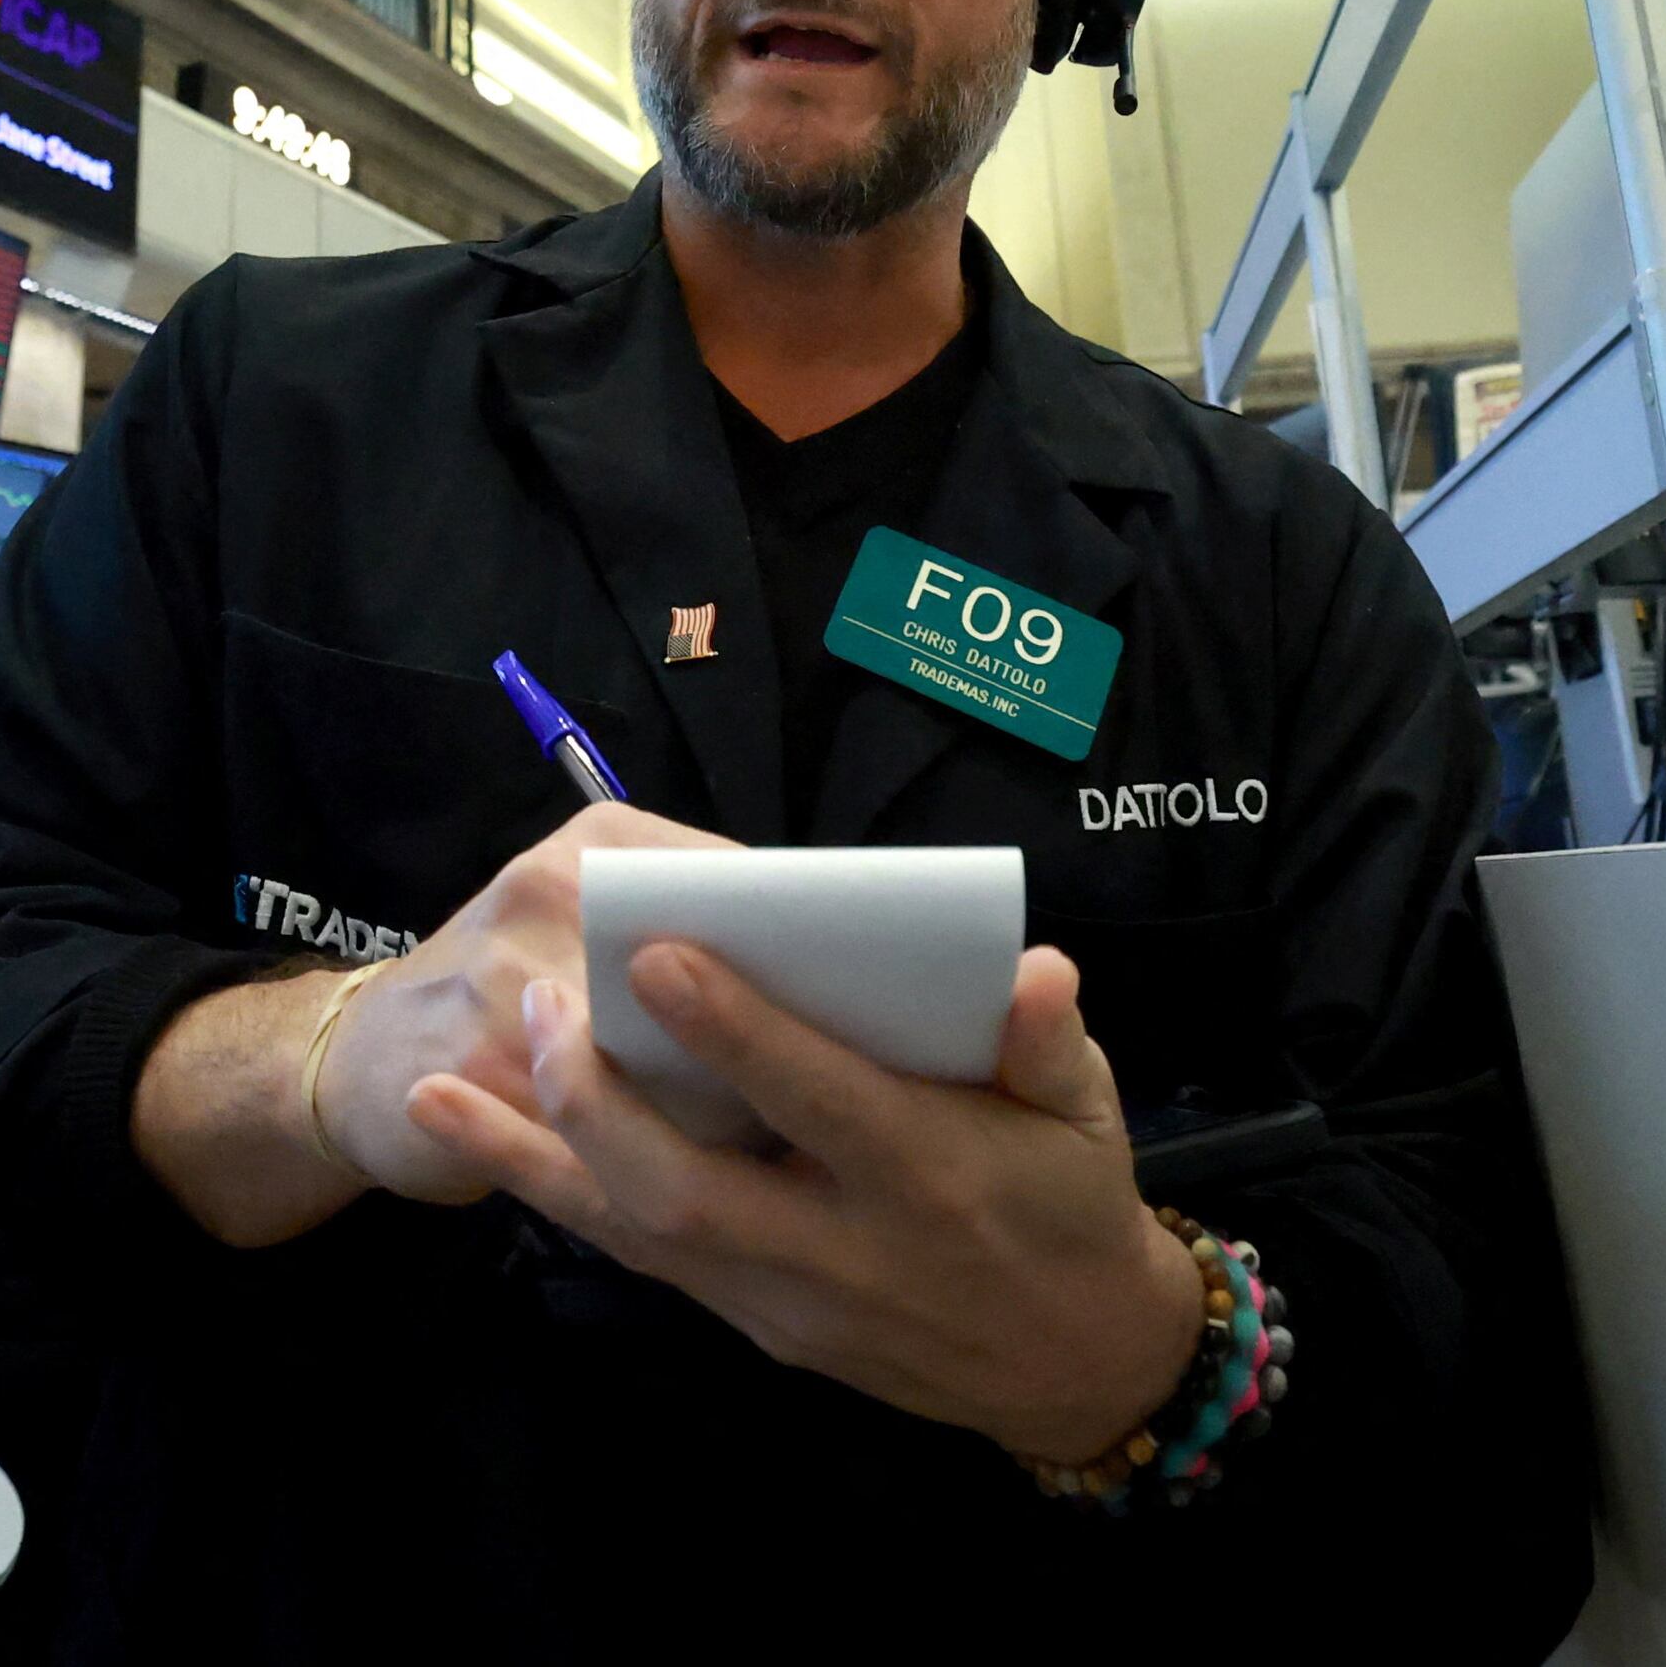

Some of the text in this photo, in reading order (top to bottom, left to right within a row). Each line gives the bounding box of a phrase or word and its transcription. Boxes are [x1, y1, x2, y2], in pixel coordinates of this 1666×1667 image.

[906, 558, 1064, 666] F09
[902, 619, 1046, 696] CHRIS DATTOLO
[908, 657, 1021, 719] TRADEMAS.INC
[1078, 777, 1269, 832] DATTOLO
